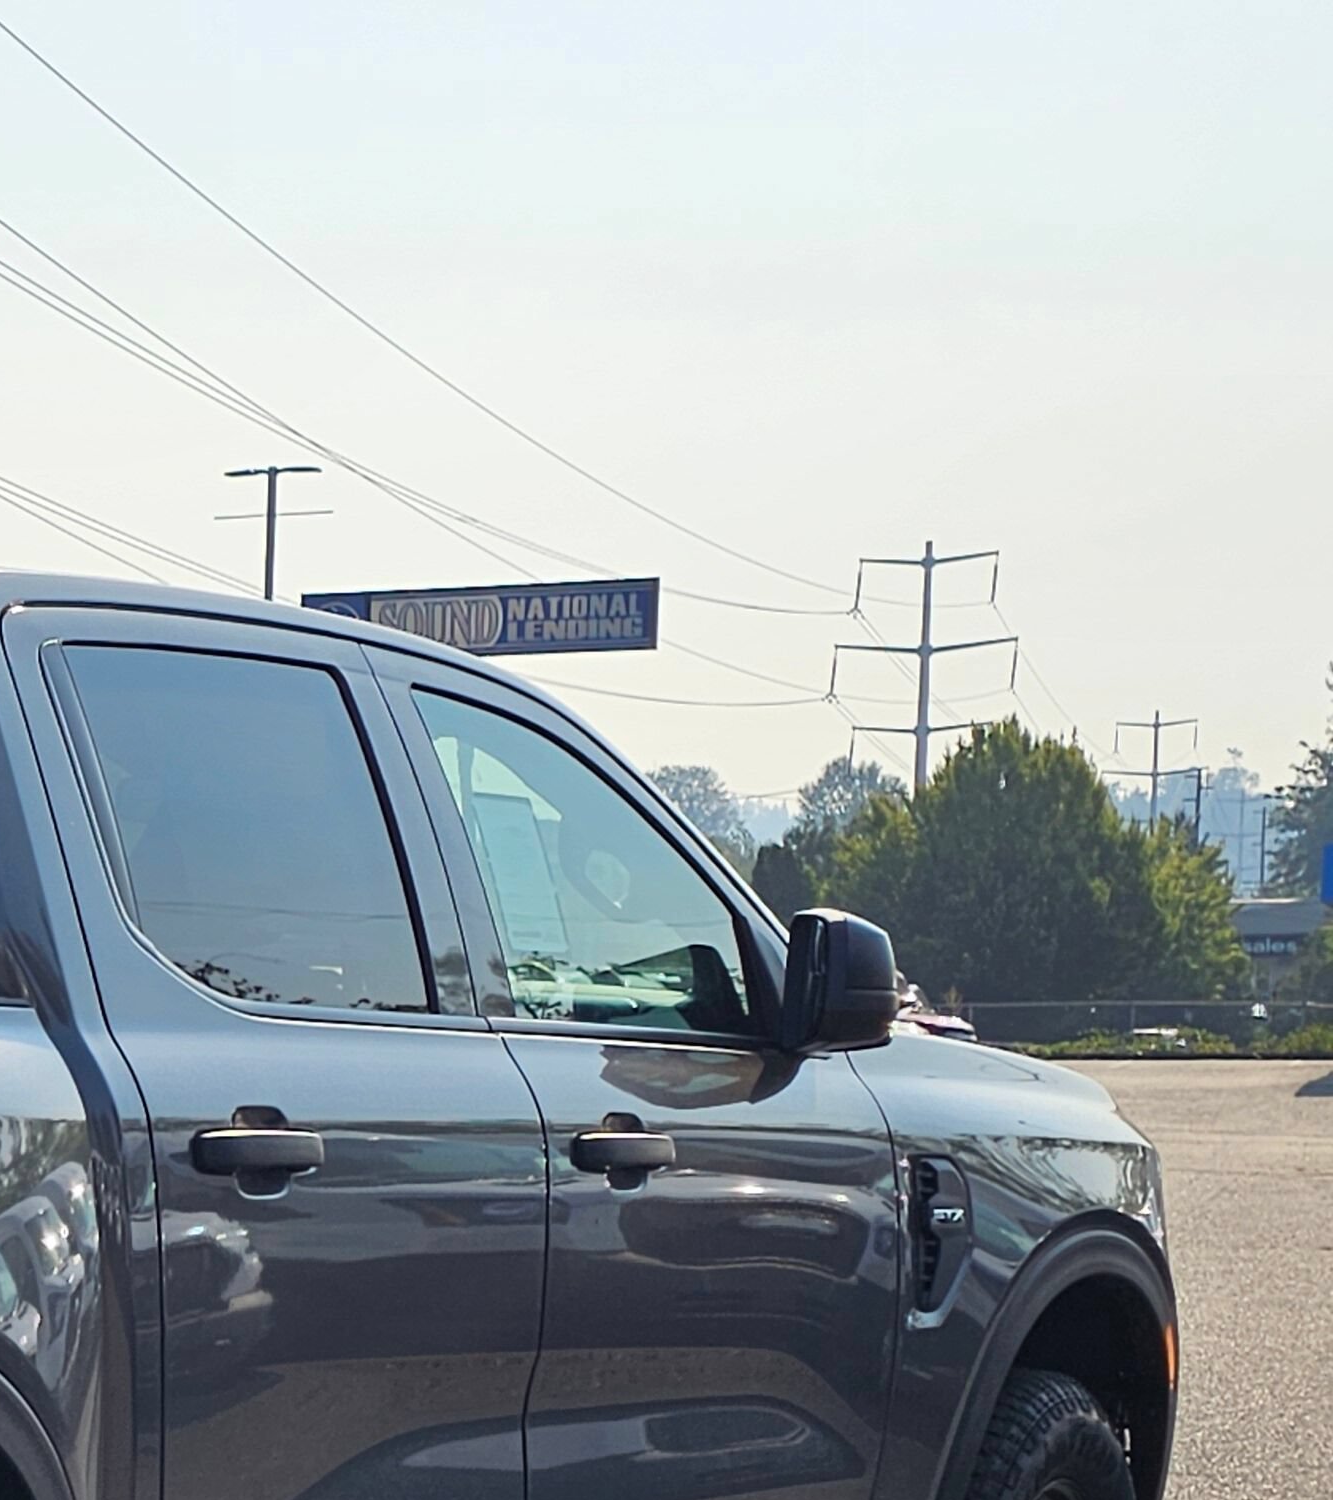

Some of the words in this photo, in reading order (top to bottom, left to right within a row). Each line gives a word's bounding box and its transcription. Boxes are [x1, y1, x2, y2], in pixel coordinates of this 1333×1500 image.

[507, 592, 643, 622] NATIONAL
[378, 599, 501, 647] SOUND
[507, 616, 643, 642] LENDING
